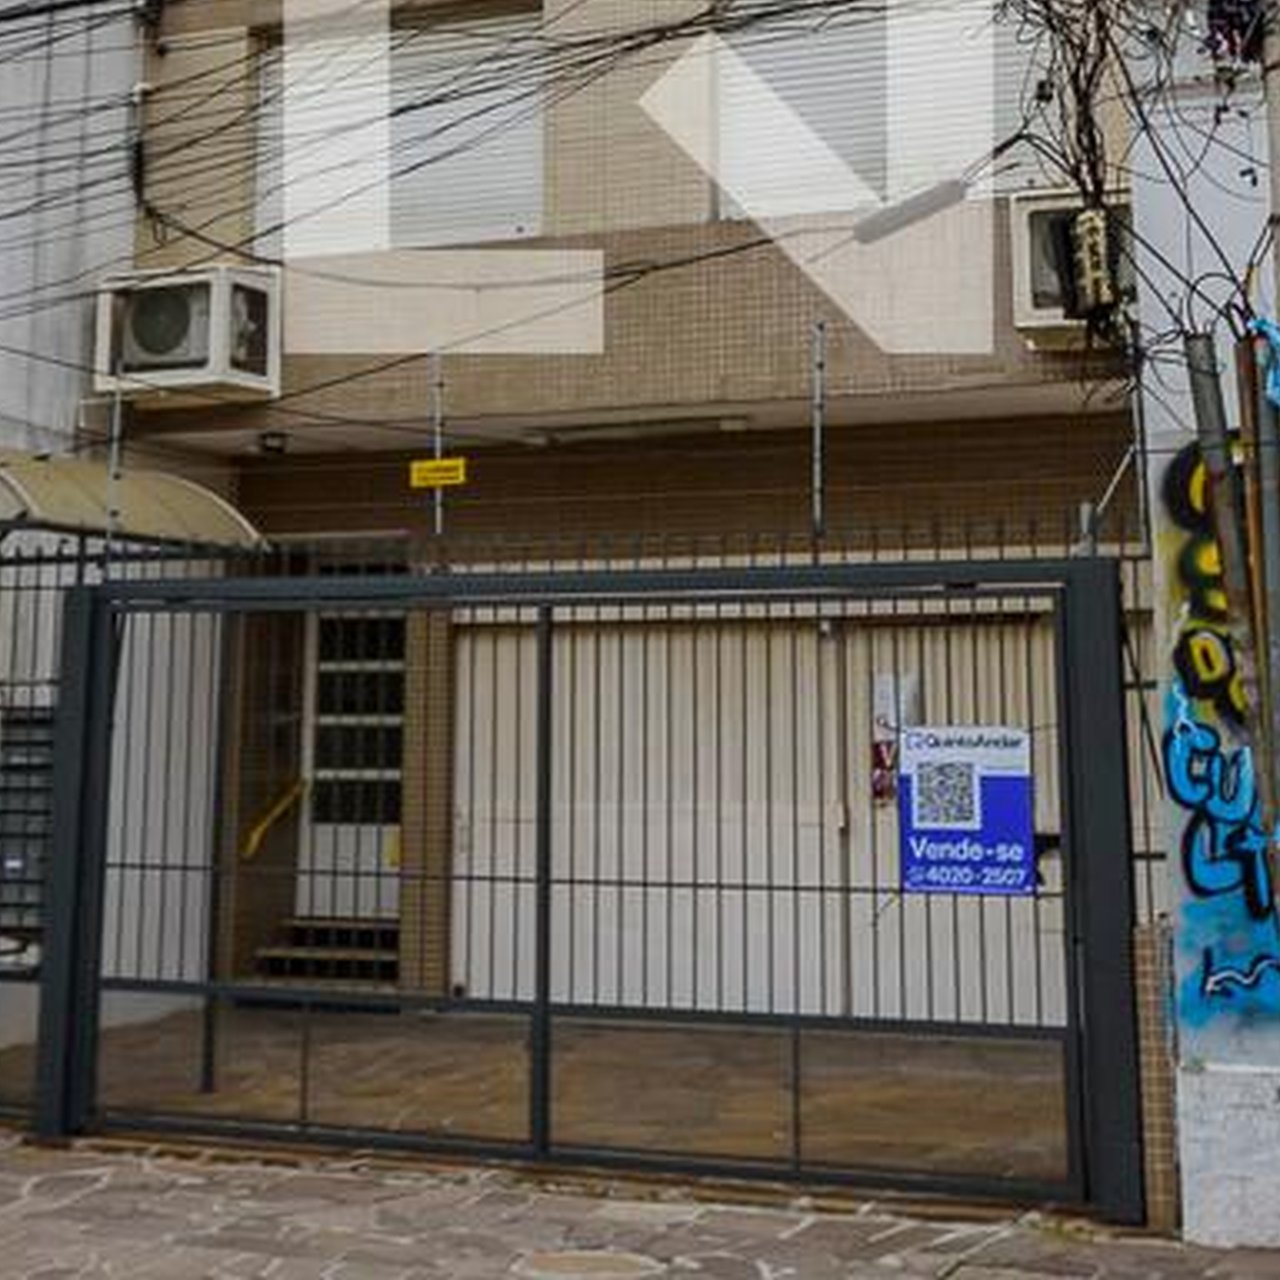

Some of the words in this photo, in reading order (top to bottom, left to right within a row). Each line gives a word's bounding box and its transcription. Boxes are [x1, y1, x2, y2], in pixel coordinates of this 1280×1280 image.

[926, 733, 1023, 749] QuintoAndar
[908, 837, 1024, 861] Vende-se
[926, 867, 1026, 886] 4020-2507
